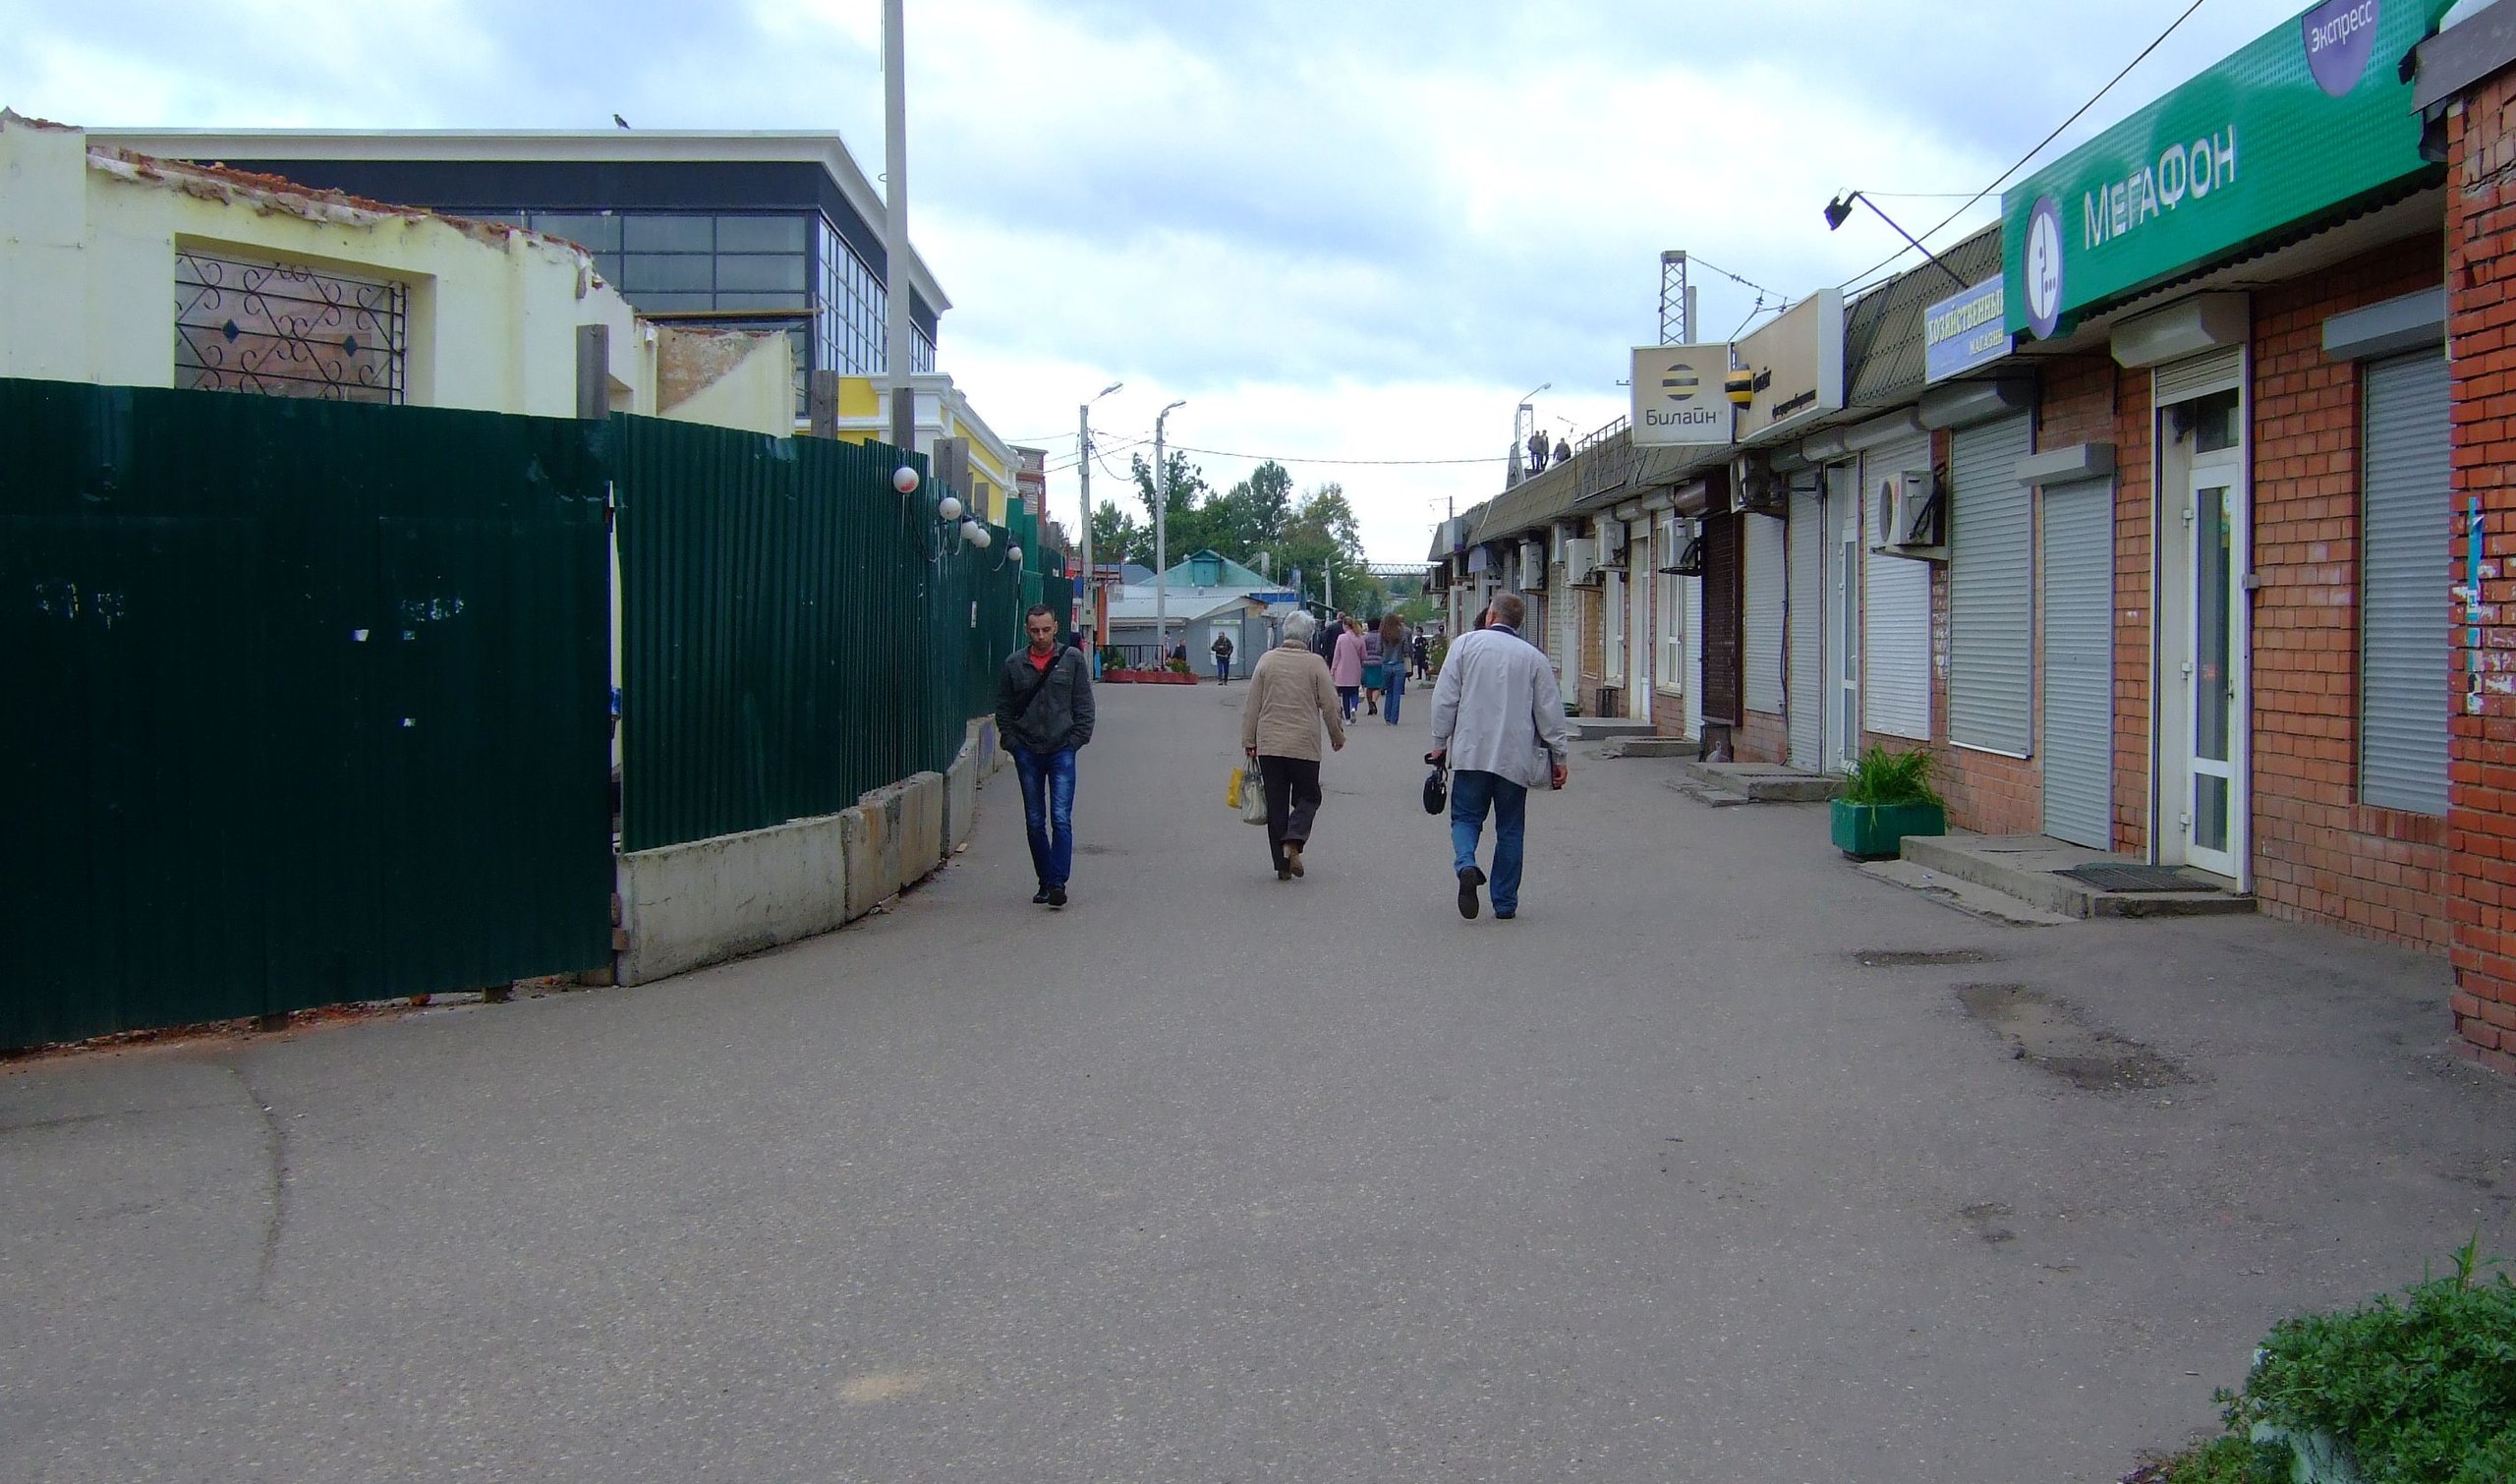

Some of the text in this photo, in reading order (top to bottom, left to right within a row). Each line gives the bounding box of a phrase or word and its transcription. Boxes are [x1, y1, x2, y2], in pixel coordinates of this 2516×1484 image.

[2312, 0, 2373, 52] экспресс
[1970, 329, 2003, 355] МАГАЗИН
[1646, 408, 1716, 426] Билайн
